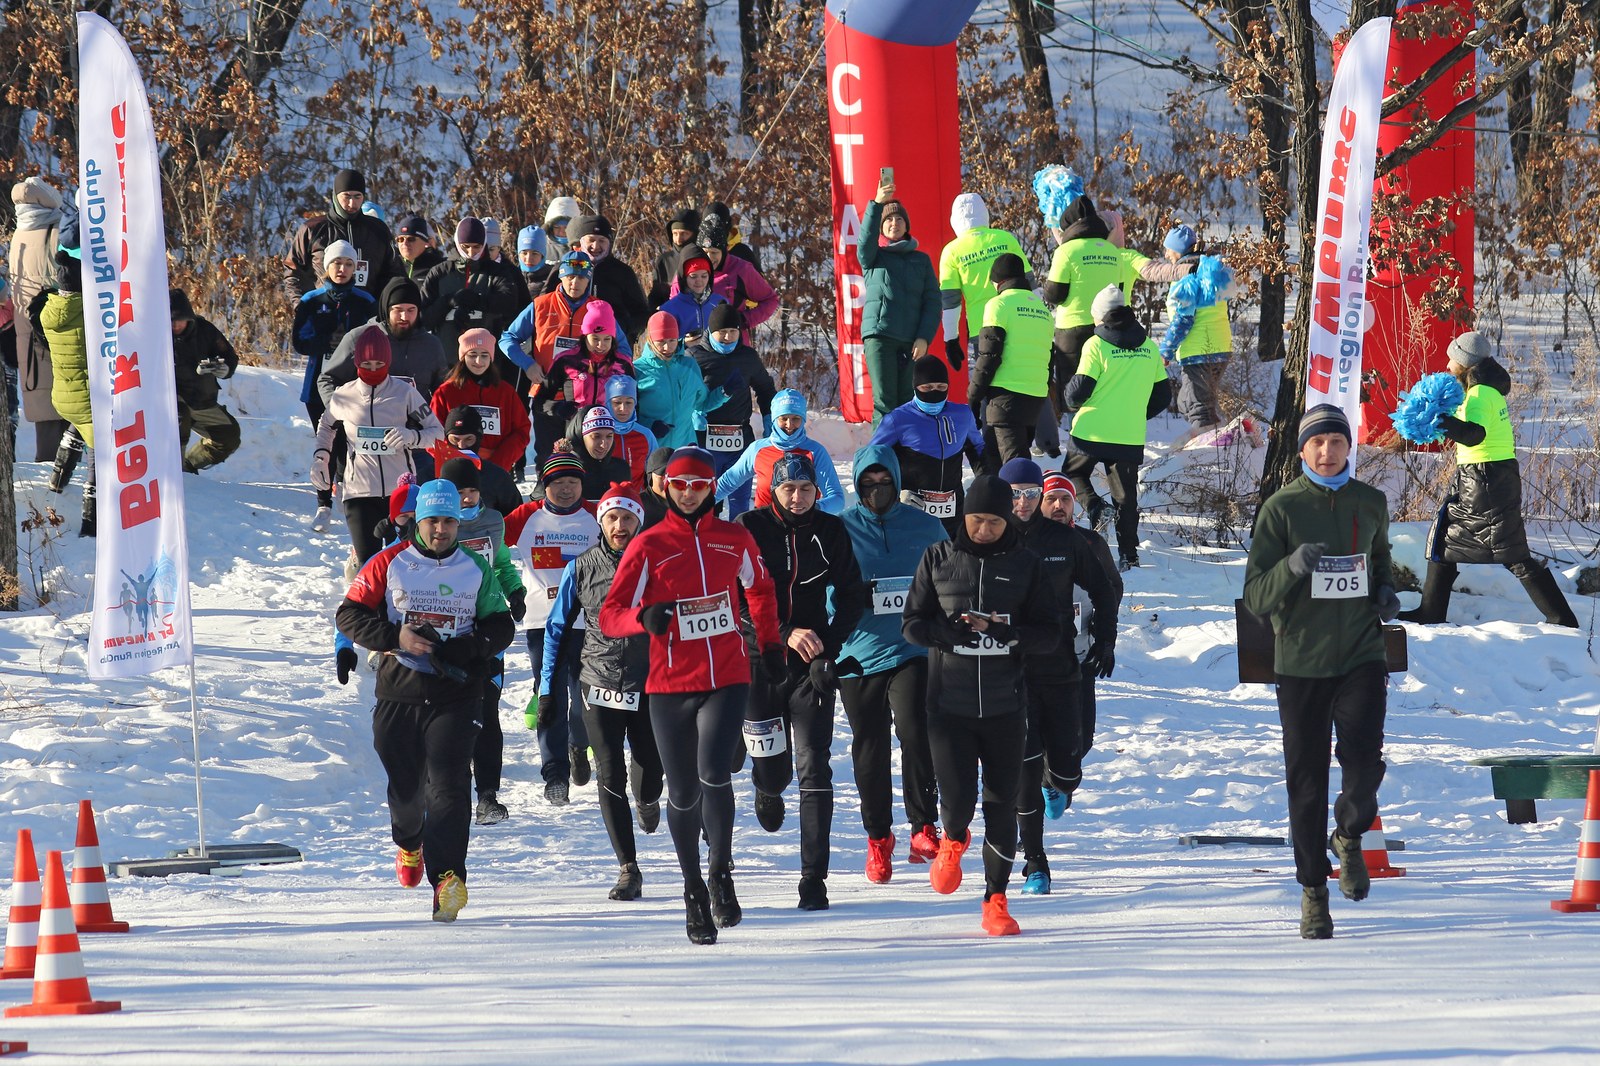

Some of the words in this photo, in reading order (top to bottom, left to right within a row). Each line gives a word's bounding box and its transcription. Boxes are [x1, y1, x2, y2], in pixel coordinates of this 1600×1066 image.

[831, 62, 866, 396] СТАРТ
[481, 420, 495, 431] 06
[362, 441, 388, 451] 406
[709, 438, 742, 448] 1000
[546, 533, 589, 542] МАРАФОН
[1324, 576, 1359, 592] 705
[409, 596, 452, 606] Marathon
[882, 595, 904, 609] 40
[409, 604, 473, 615] AFGHANISTAN
[686, 613, 728, 634] 1016
[594, 688, 636, 705] 1003
[749, 737, 775, 752] 717
